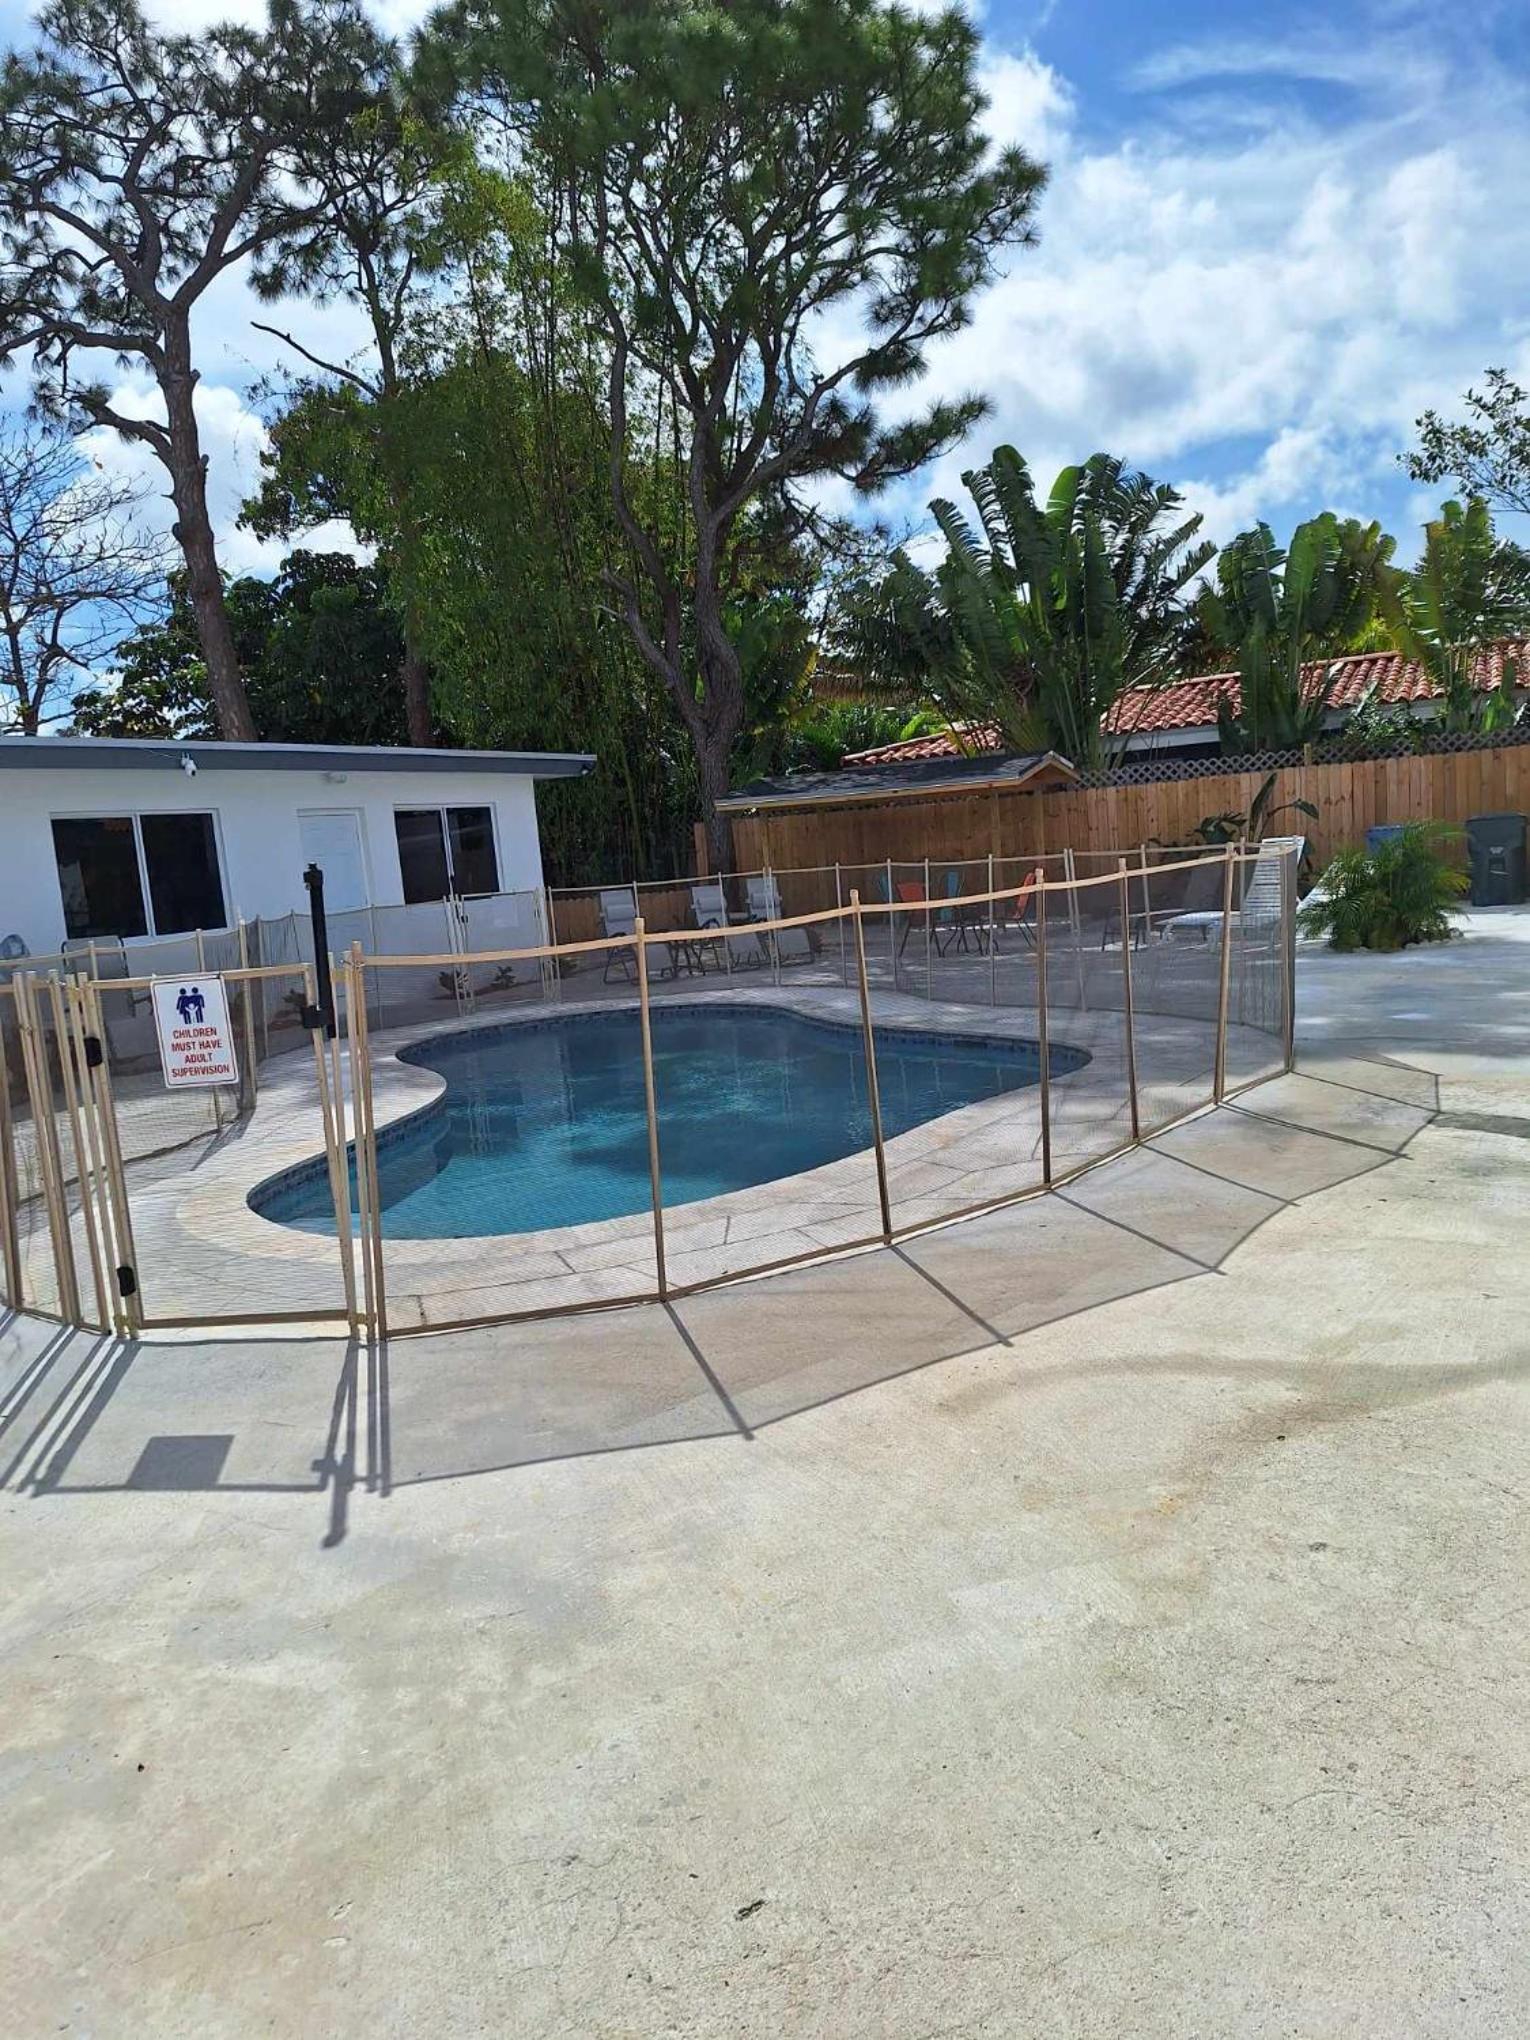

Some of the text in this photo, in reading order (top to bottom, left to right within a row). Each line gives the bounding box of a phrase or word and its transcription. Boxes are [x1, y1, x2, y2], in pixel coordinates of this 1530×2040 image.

[172, 1026, 217, 1040] CHILDREN
[171, 1039, 223, 1052] MUST HAVE
[184, 1052, 213, 1064] ADULT
[171, 1064, 230, 1078] SUPERVISION
